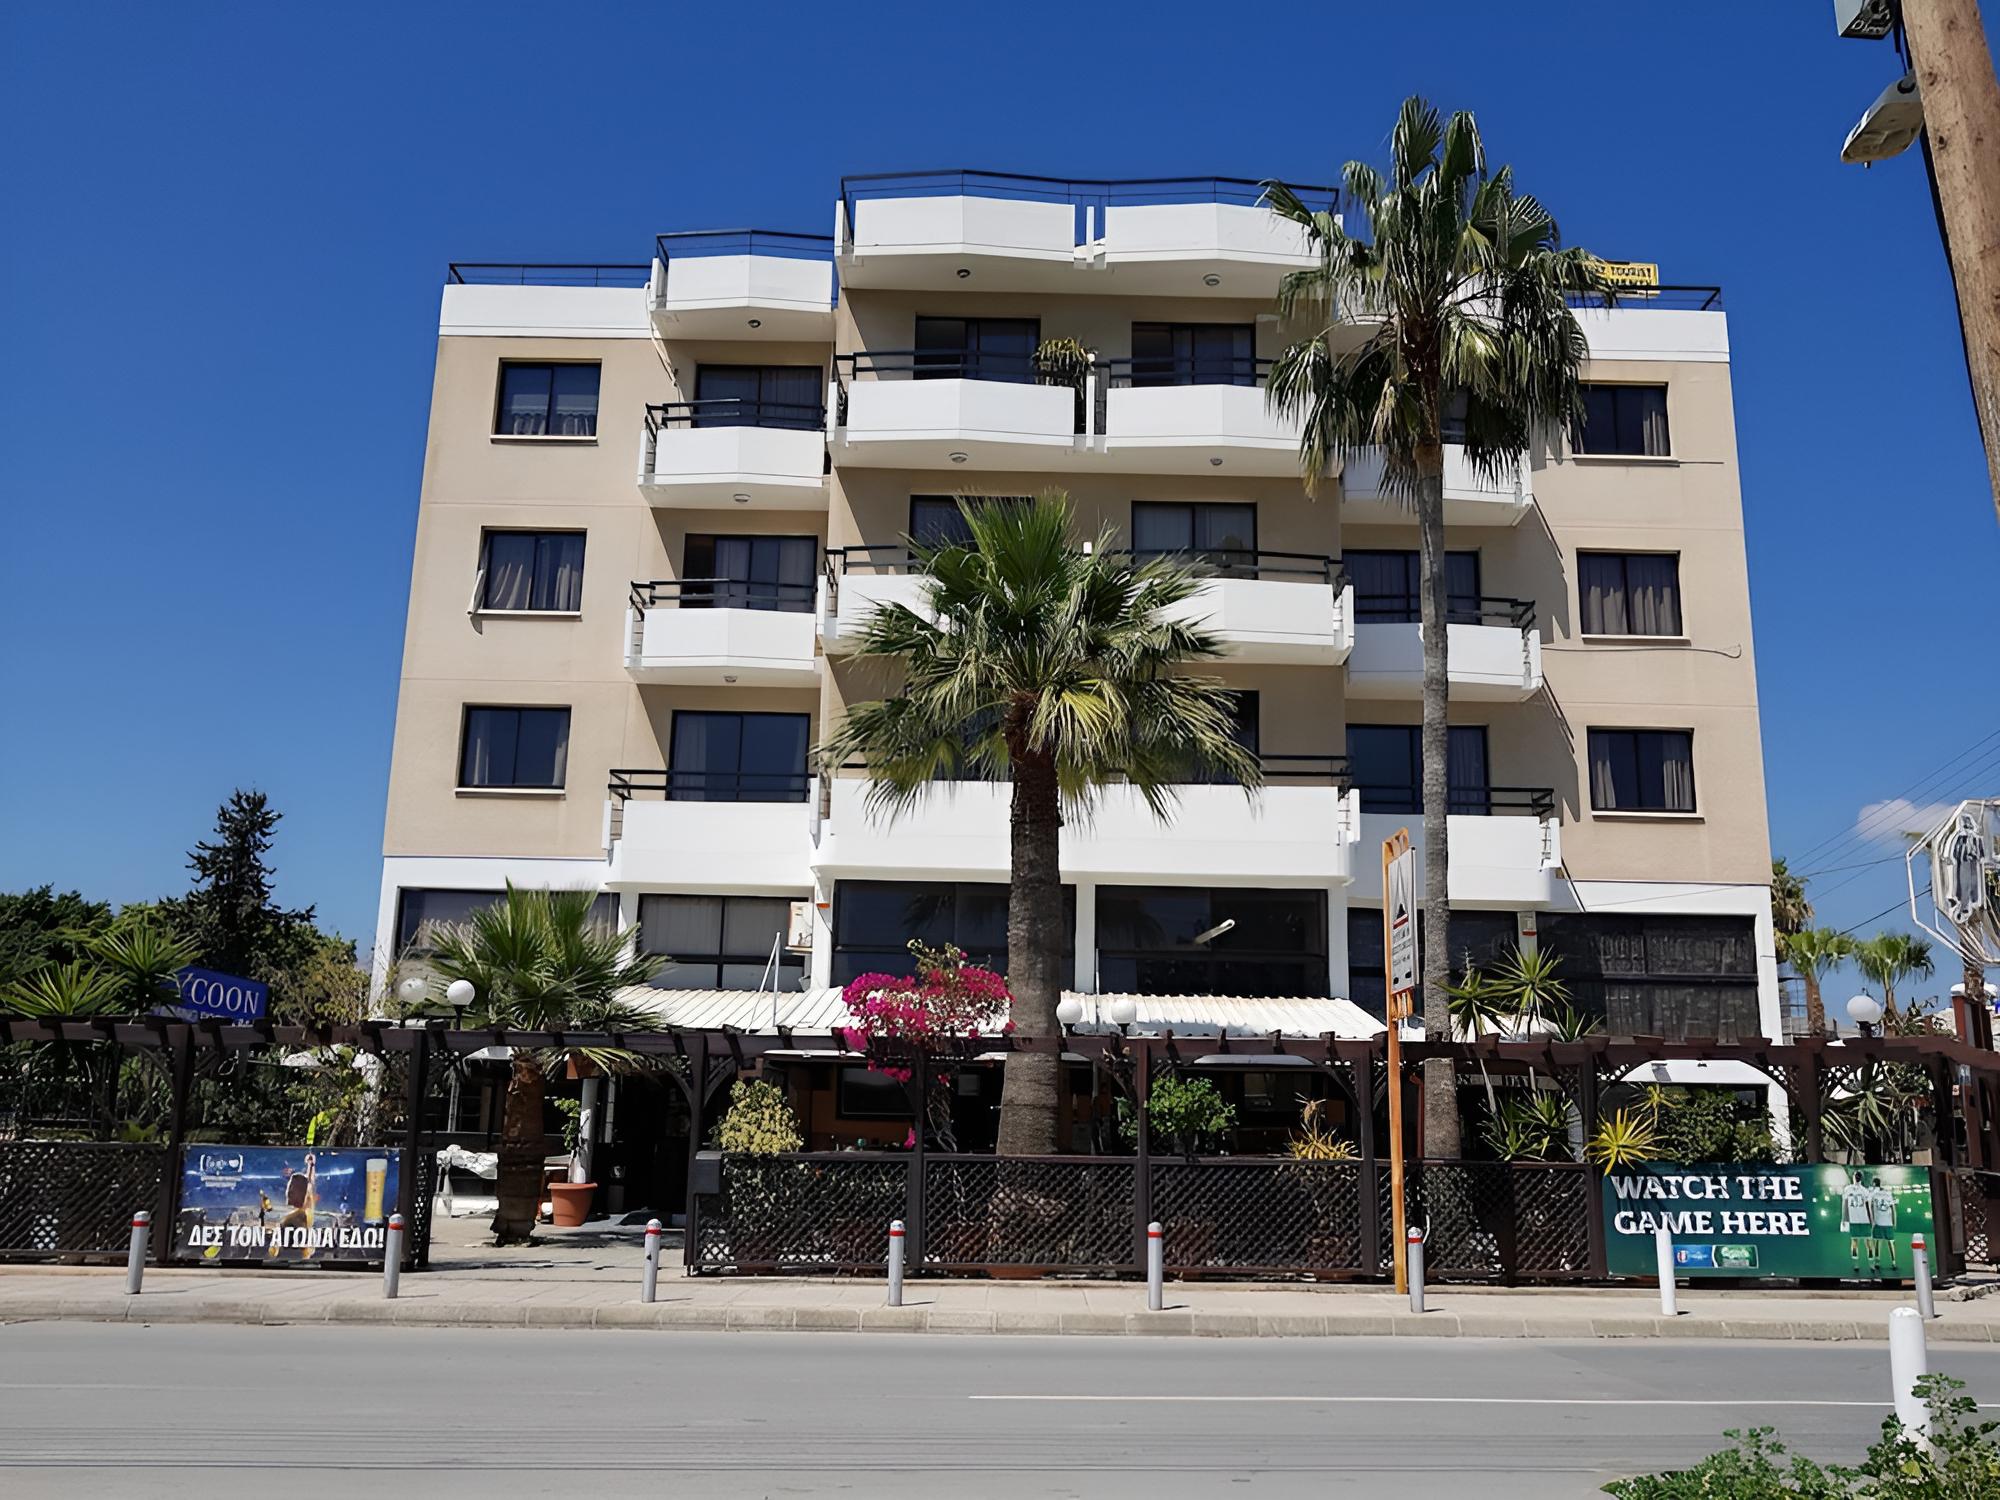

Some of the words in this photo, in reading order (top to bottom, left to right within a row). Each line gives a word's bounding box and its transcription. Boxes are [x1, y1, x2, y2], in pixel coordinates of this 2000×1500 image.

[1610, 1175, 1730, 1200] WATCH
[1736, 1175, 1804, 1200] THE
[1614, 1211, 1715, 1235] GAME
[1721, 1211, 1810, 1236] HERE
[188, 1224, 223, 1247] ΔΕΣ
[227, 1225, 266, 1248] ΤΟΝ
[339, 1227, 385, 1249] ΕΔΩ!
